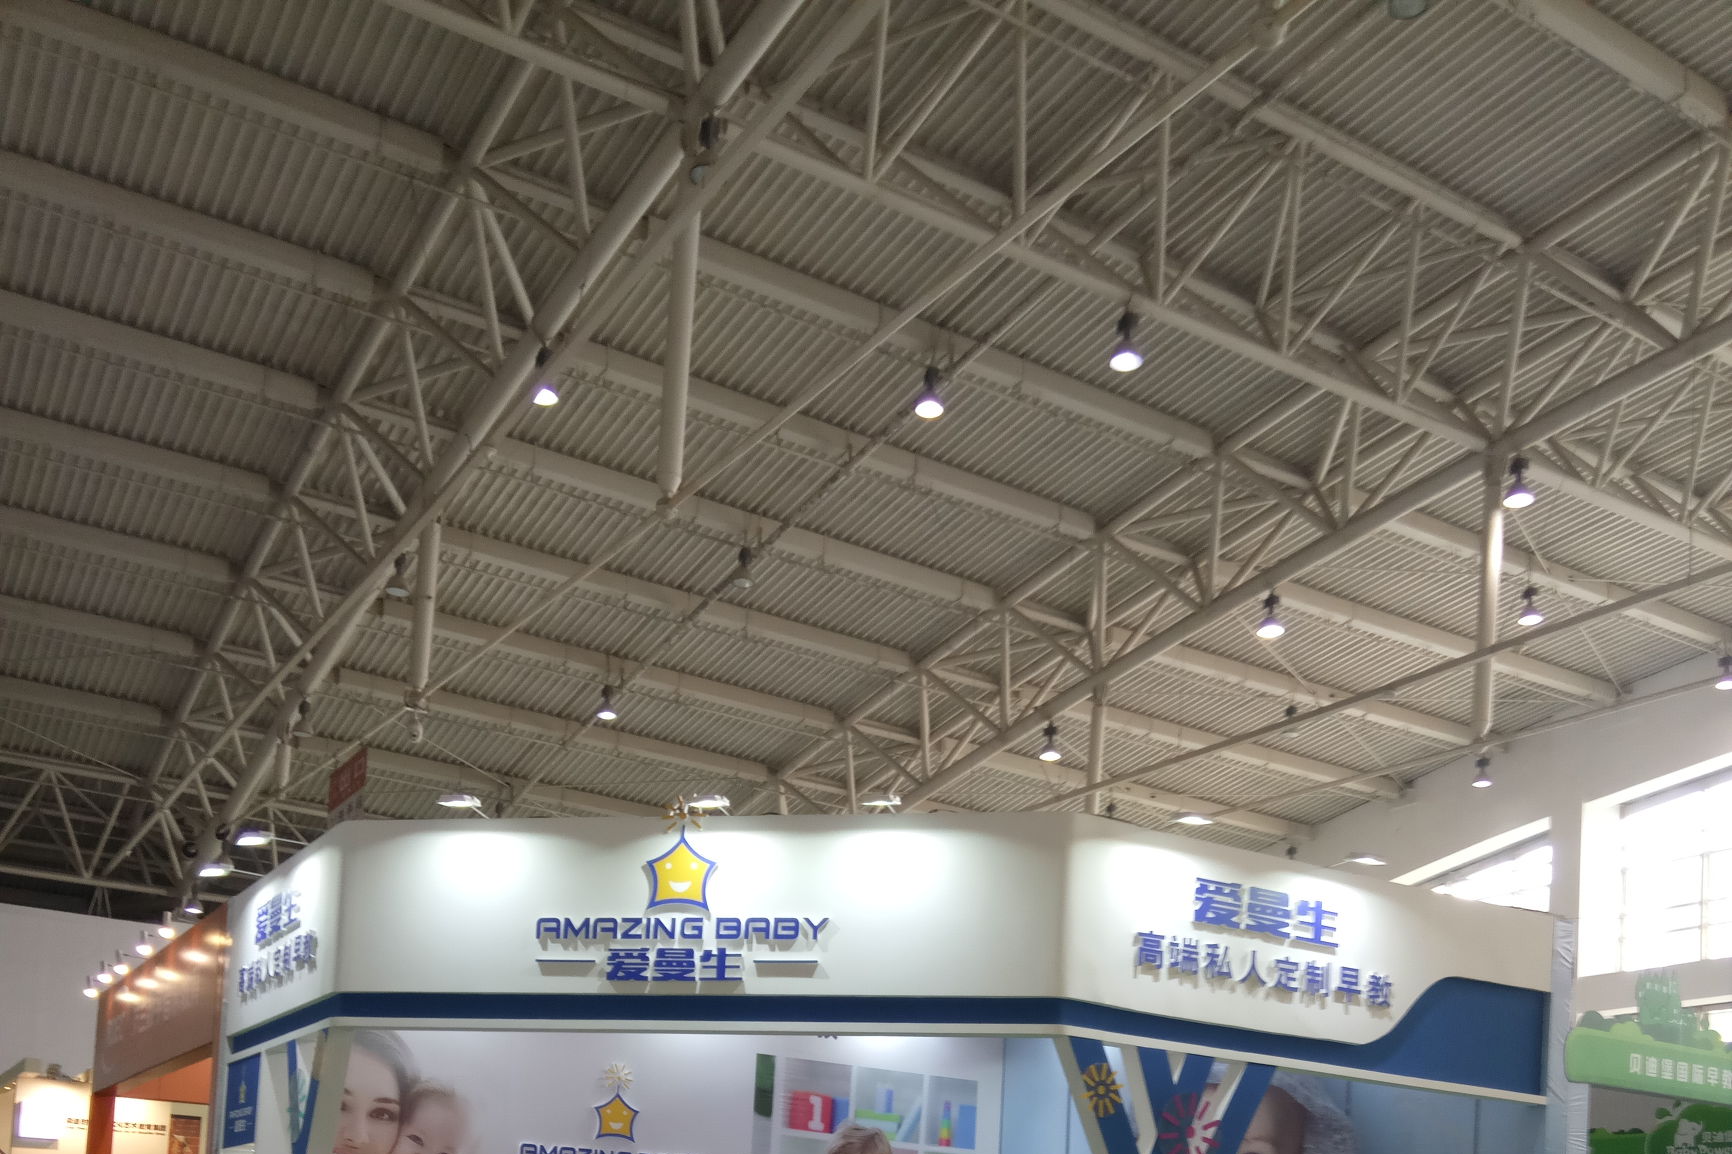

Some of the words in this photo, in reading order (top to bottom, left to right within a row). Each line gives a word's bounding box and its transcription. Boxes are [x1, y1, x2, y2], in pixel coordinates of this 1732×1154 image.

[255, 891, 300, 945] 爱曼生
[536, 917, 704, 940] AMAZING
[715, 917, 830, 940] BABY
[1194, 877, 1339, 948] 爱曼生
[606, 948, 742, 981] 爱曼生
[1137, 931, 1392, 1008] 高端私人定制早教
